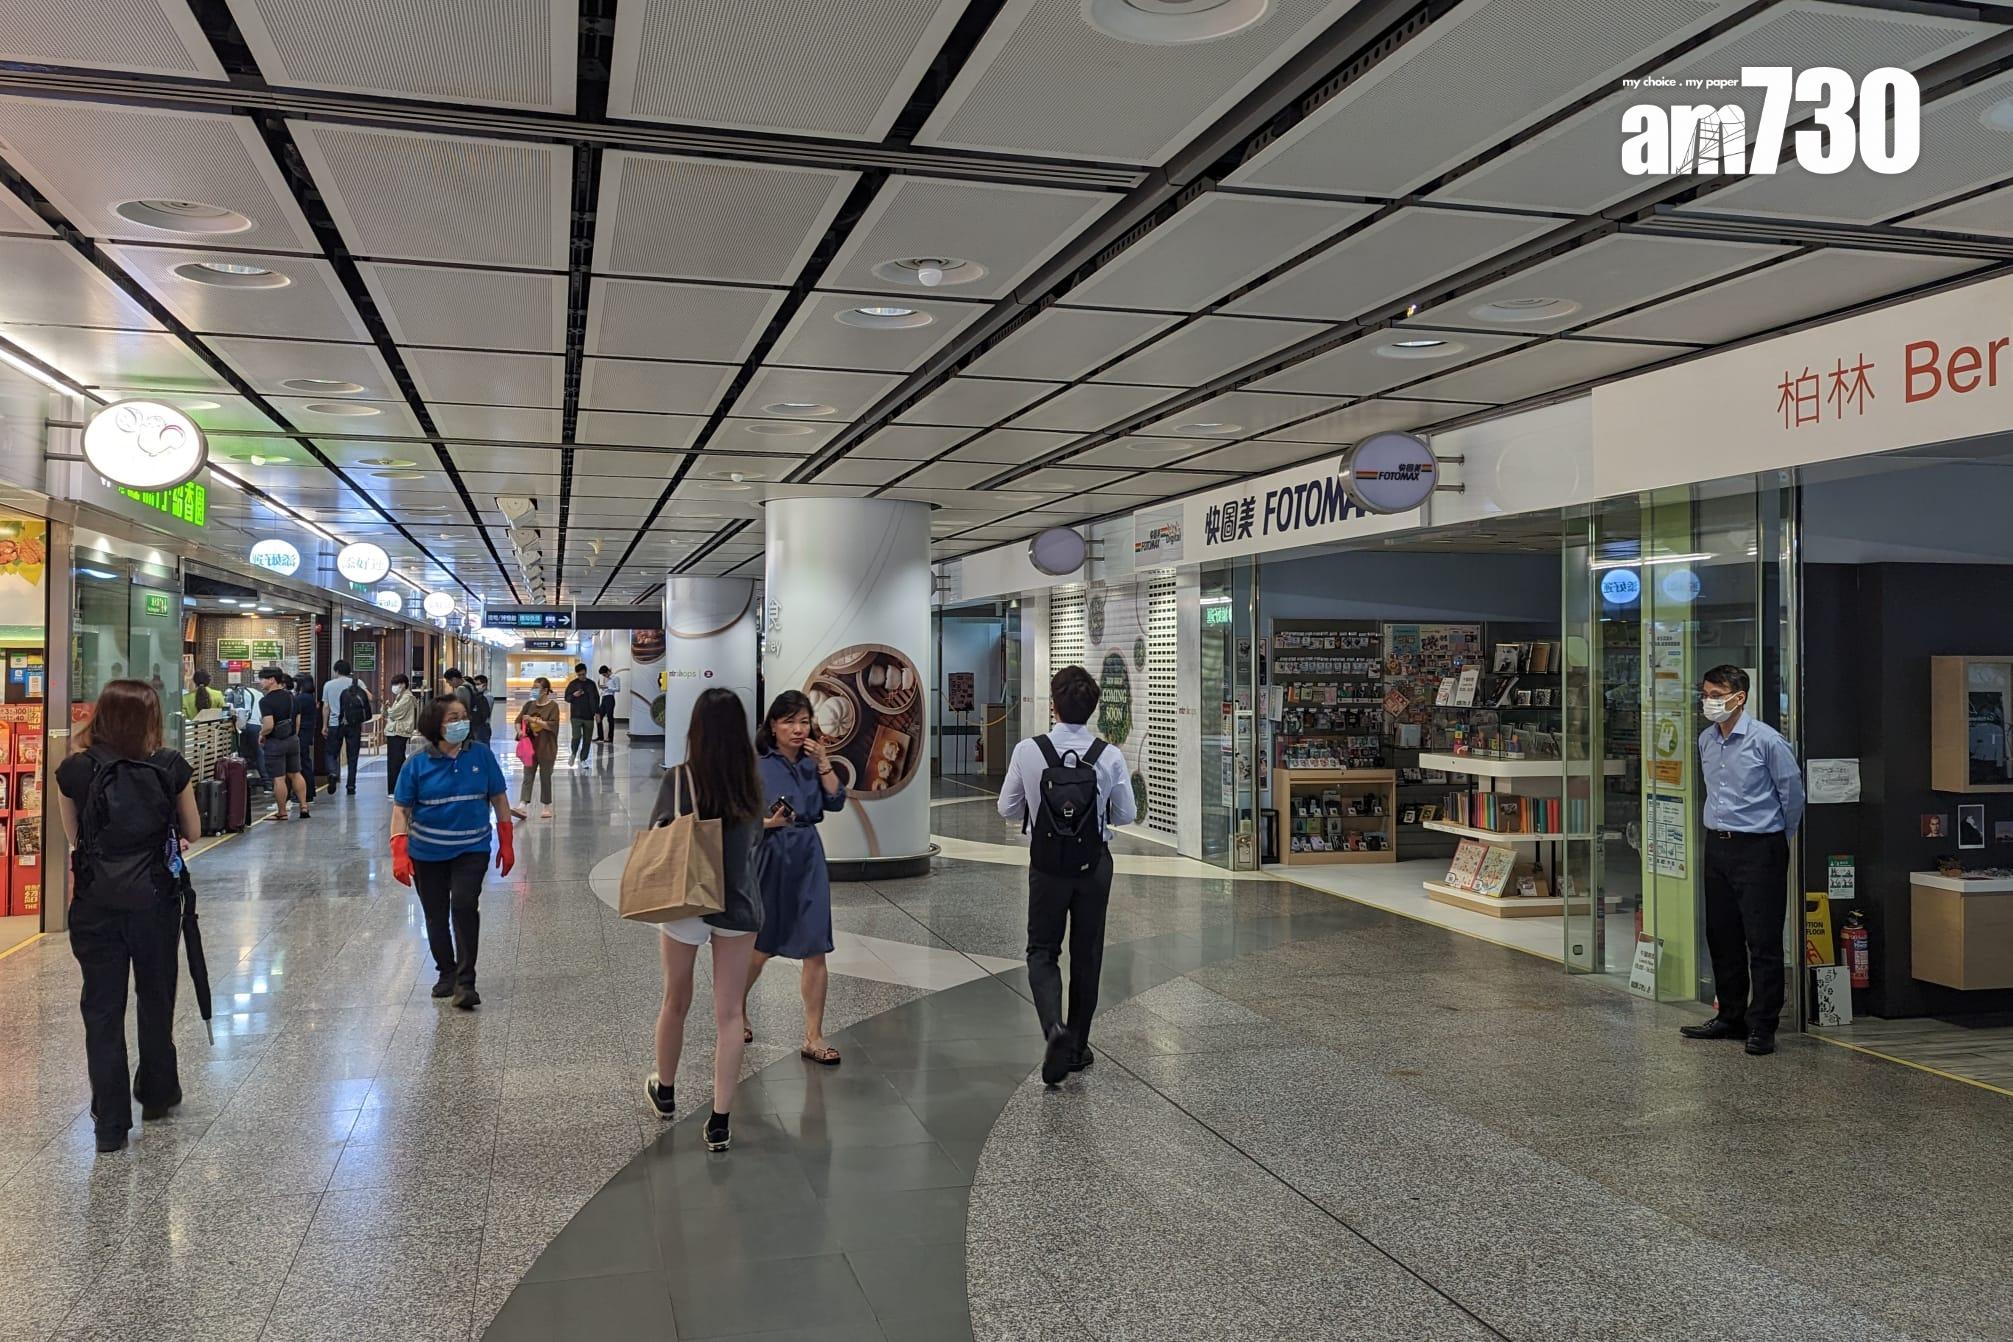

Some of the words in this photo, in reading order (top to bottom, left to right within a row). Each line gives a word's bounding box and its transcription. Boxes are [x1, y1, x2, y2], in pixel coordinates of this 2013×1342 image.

[1777, 352, 1876, 430] 柏林
[1904, 336, 2010, 404] Ber
[1378, 472, 1421, 481] FOTOMAX
[1205, 495, 1257, 545] 快圖美
[1262, 476, 1367, 536] FOTOMA
[1102, 689, 1127, 703] COMING
[1106, 707, 1123, 721] SOON
